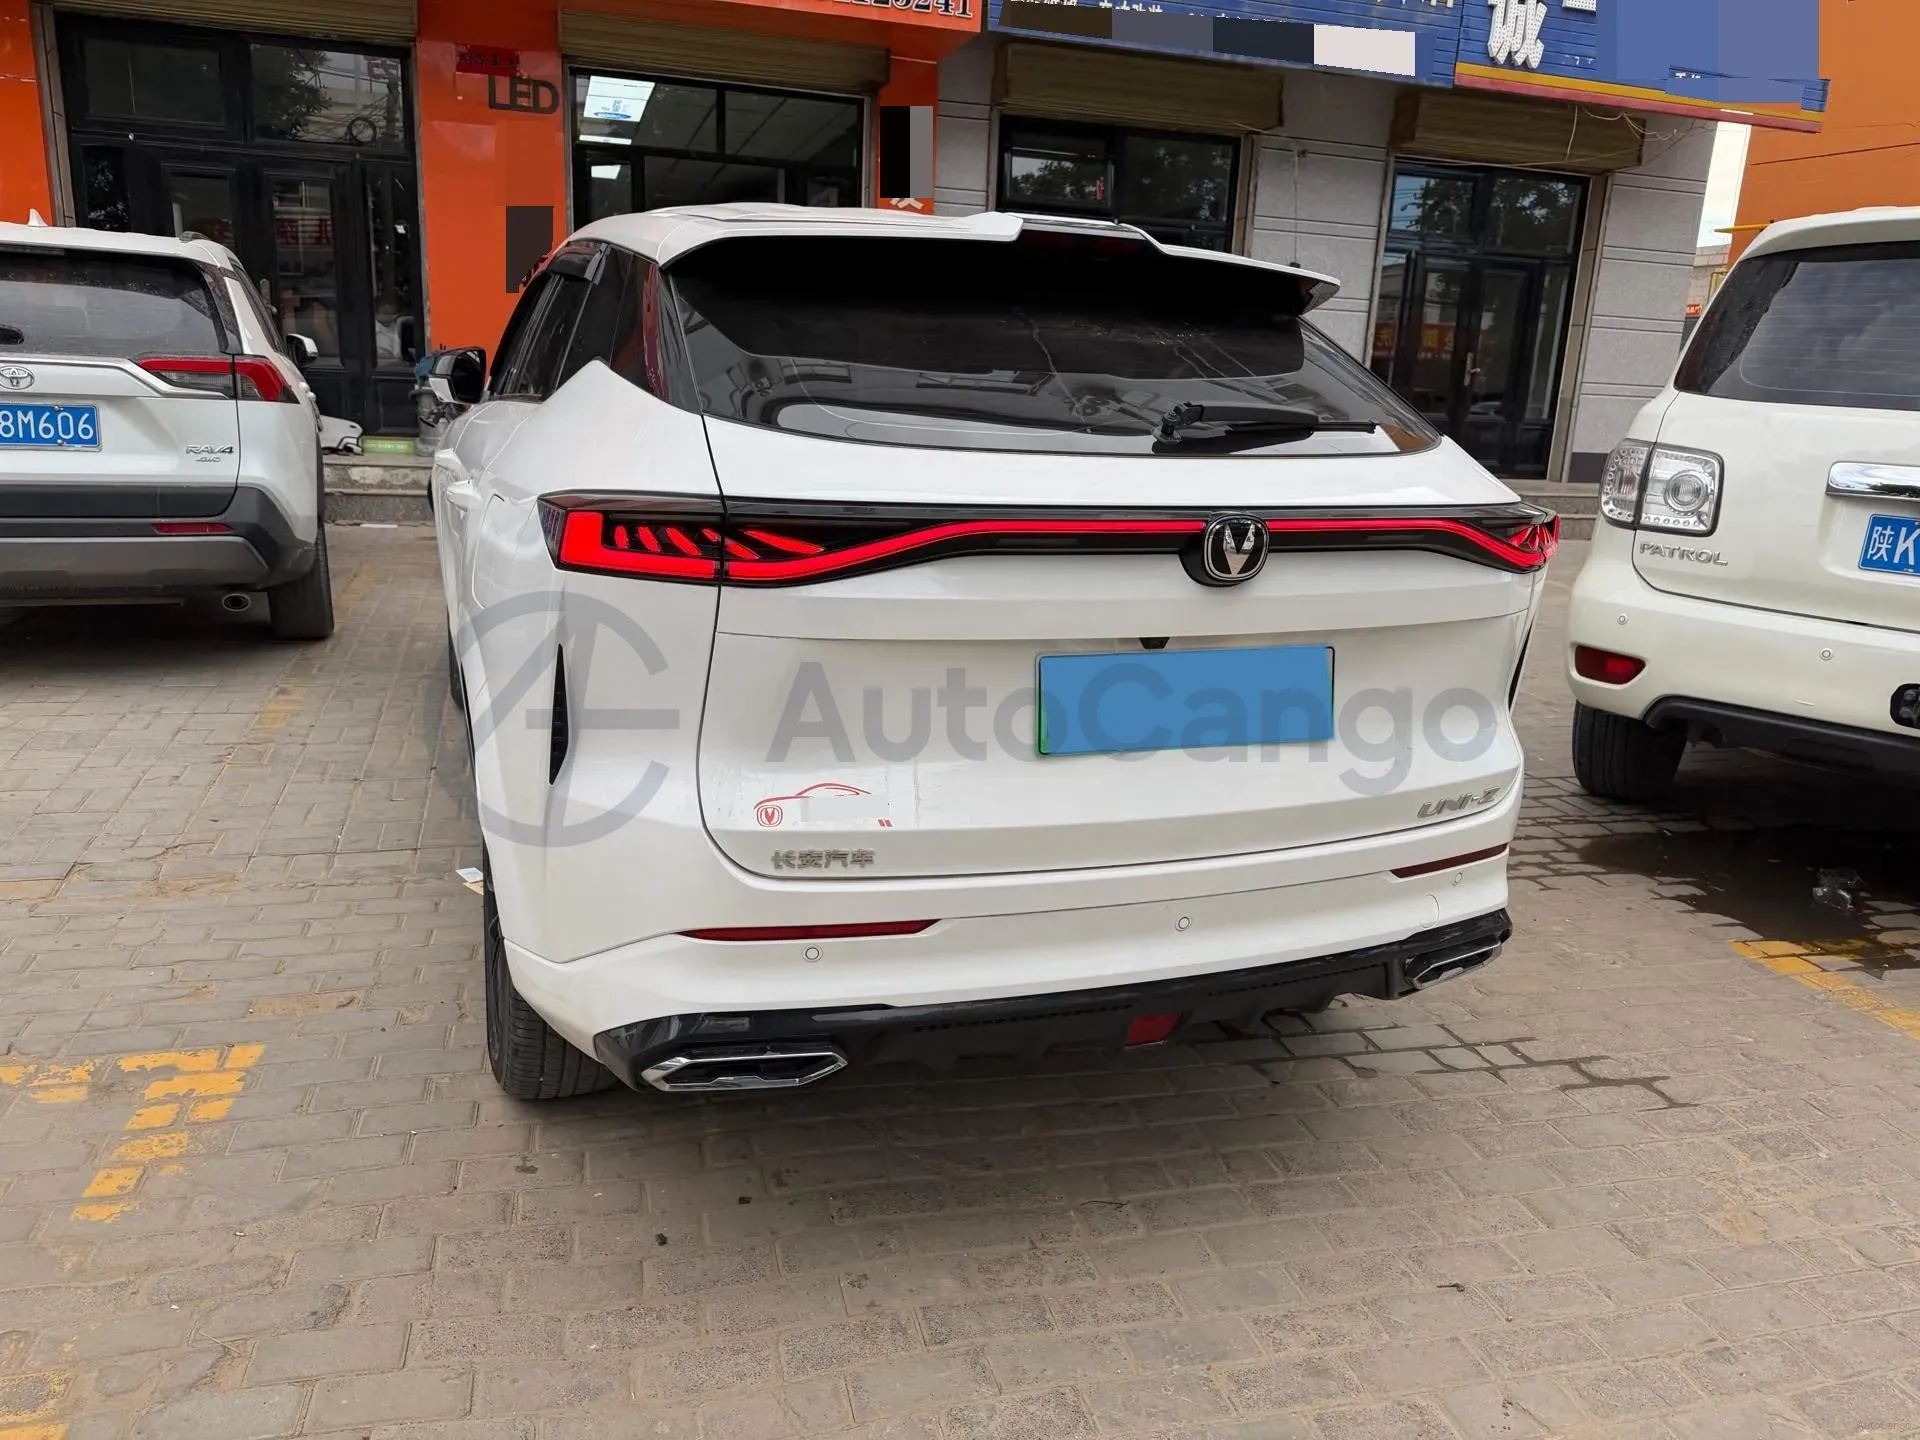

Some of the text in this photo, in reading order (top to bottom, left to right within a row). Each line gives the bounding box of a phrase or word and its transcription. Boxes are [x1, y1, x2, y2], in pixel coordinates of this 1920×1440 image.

[488, 73, 559, 114] LED
[0, 410, 94, 440] 8M606
[185, 445, 234, 455] RAV4
[1640, 541, 1729, 567] PATROL
[770, 847, 876, 871] 长安汽车
